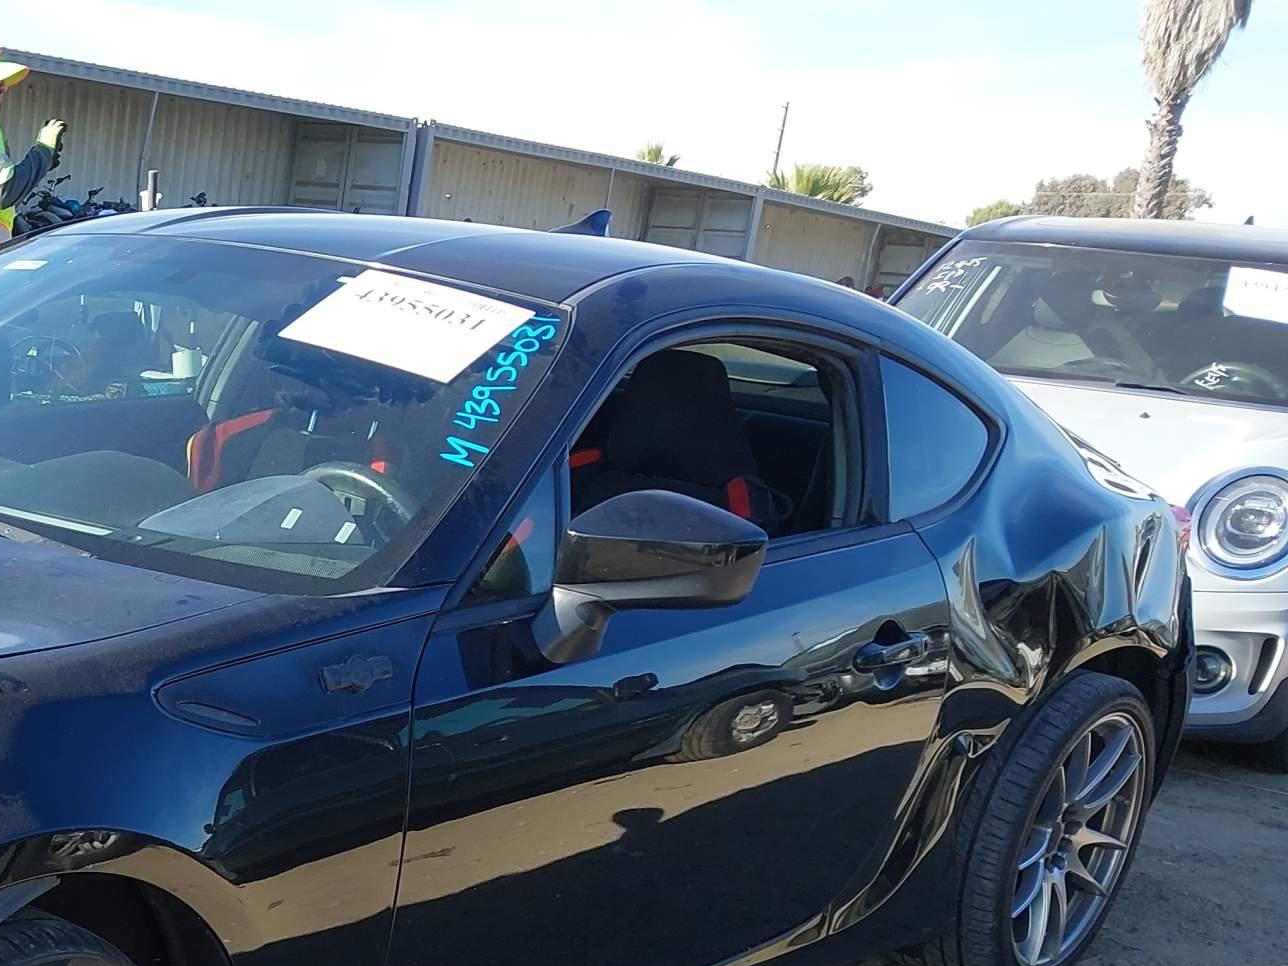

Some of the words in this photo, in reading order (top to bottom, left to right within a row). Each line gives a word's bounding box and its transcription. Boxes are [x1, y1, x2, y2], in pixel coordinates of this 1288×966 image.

[355, 289, 487, 330] 43955031
[453, 315, 562, 430] 43955031
[439, 435, 491, 468] M
